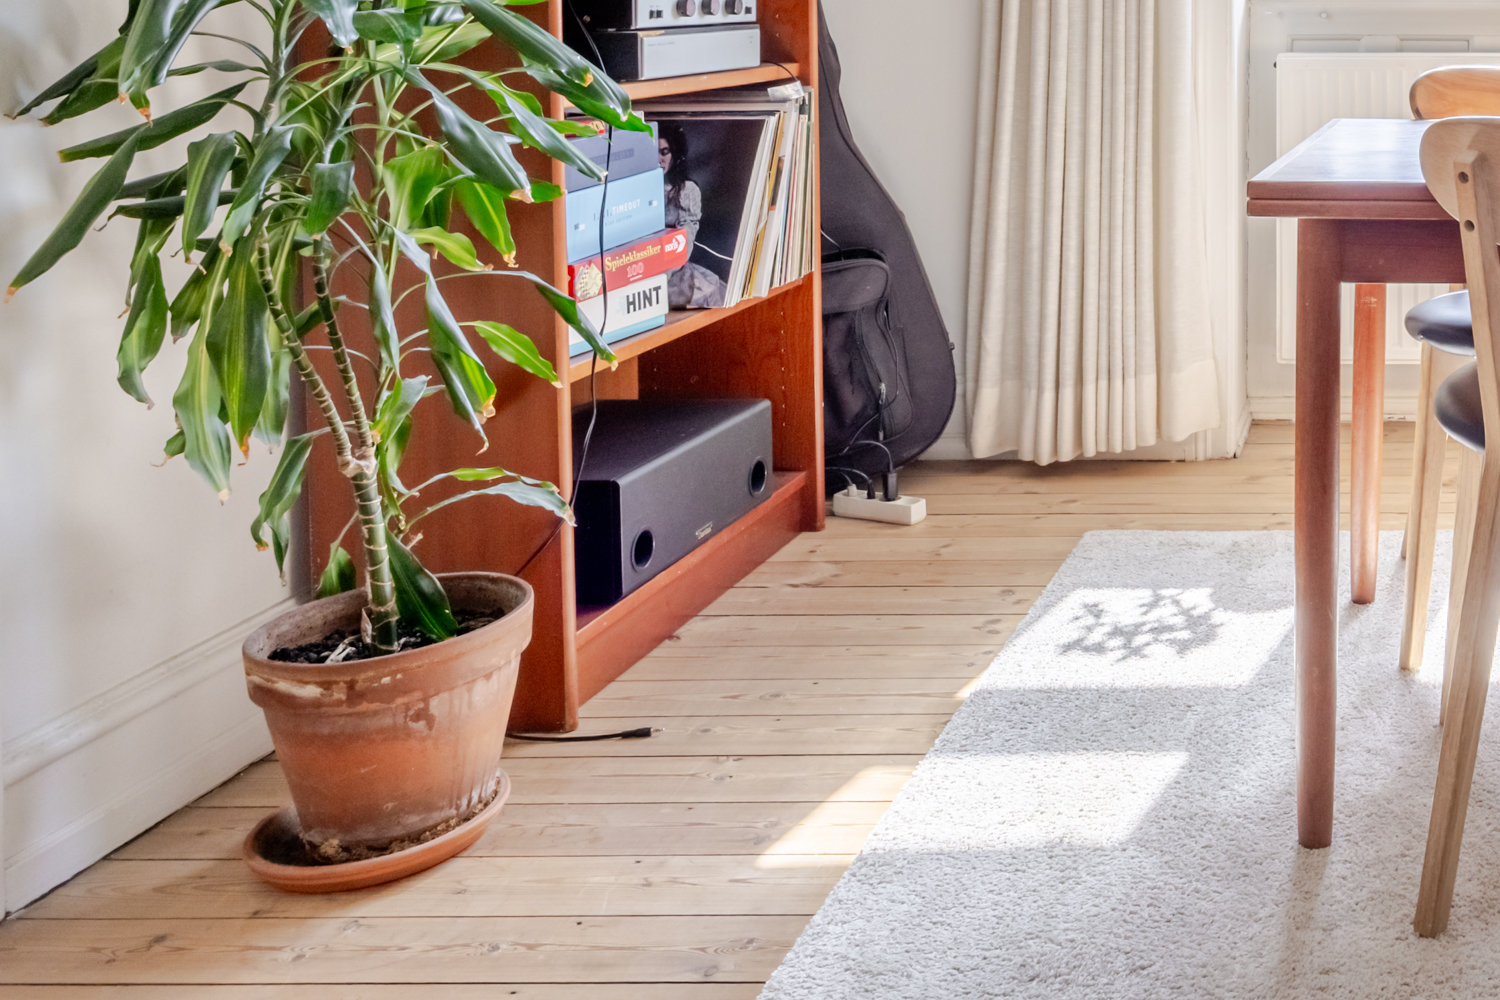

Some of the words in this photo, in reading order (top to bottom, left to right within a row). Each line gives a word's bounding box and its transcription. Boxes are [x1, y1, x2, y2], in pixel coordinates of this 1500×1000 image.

[612, 199, 641, 216] TIMEOUT
[605, 245, 661, 272] Spieleklassiker
[627, 262, 644, 278] 100
[626, 285, 661, 314] HINT
